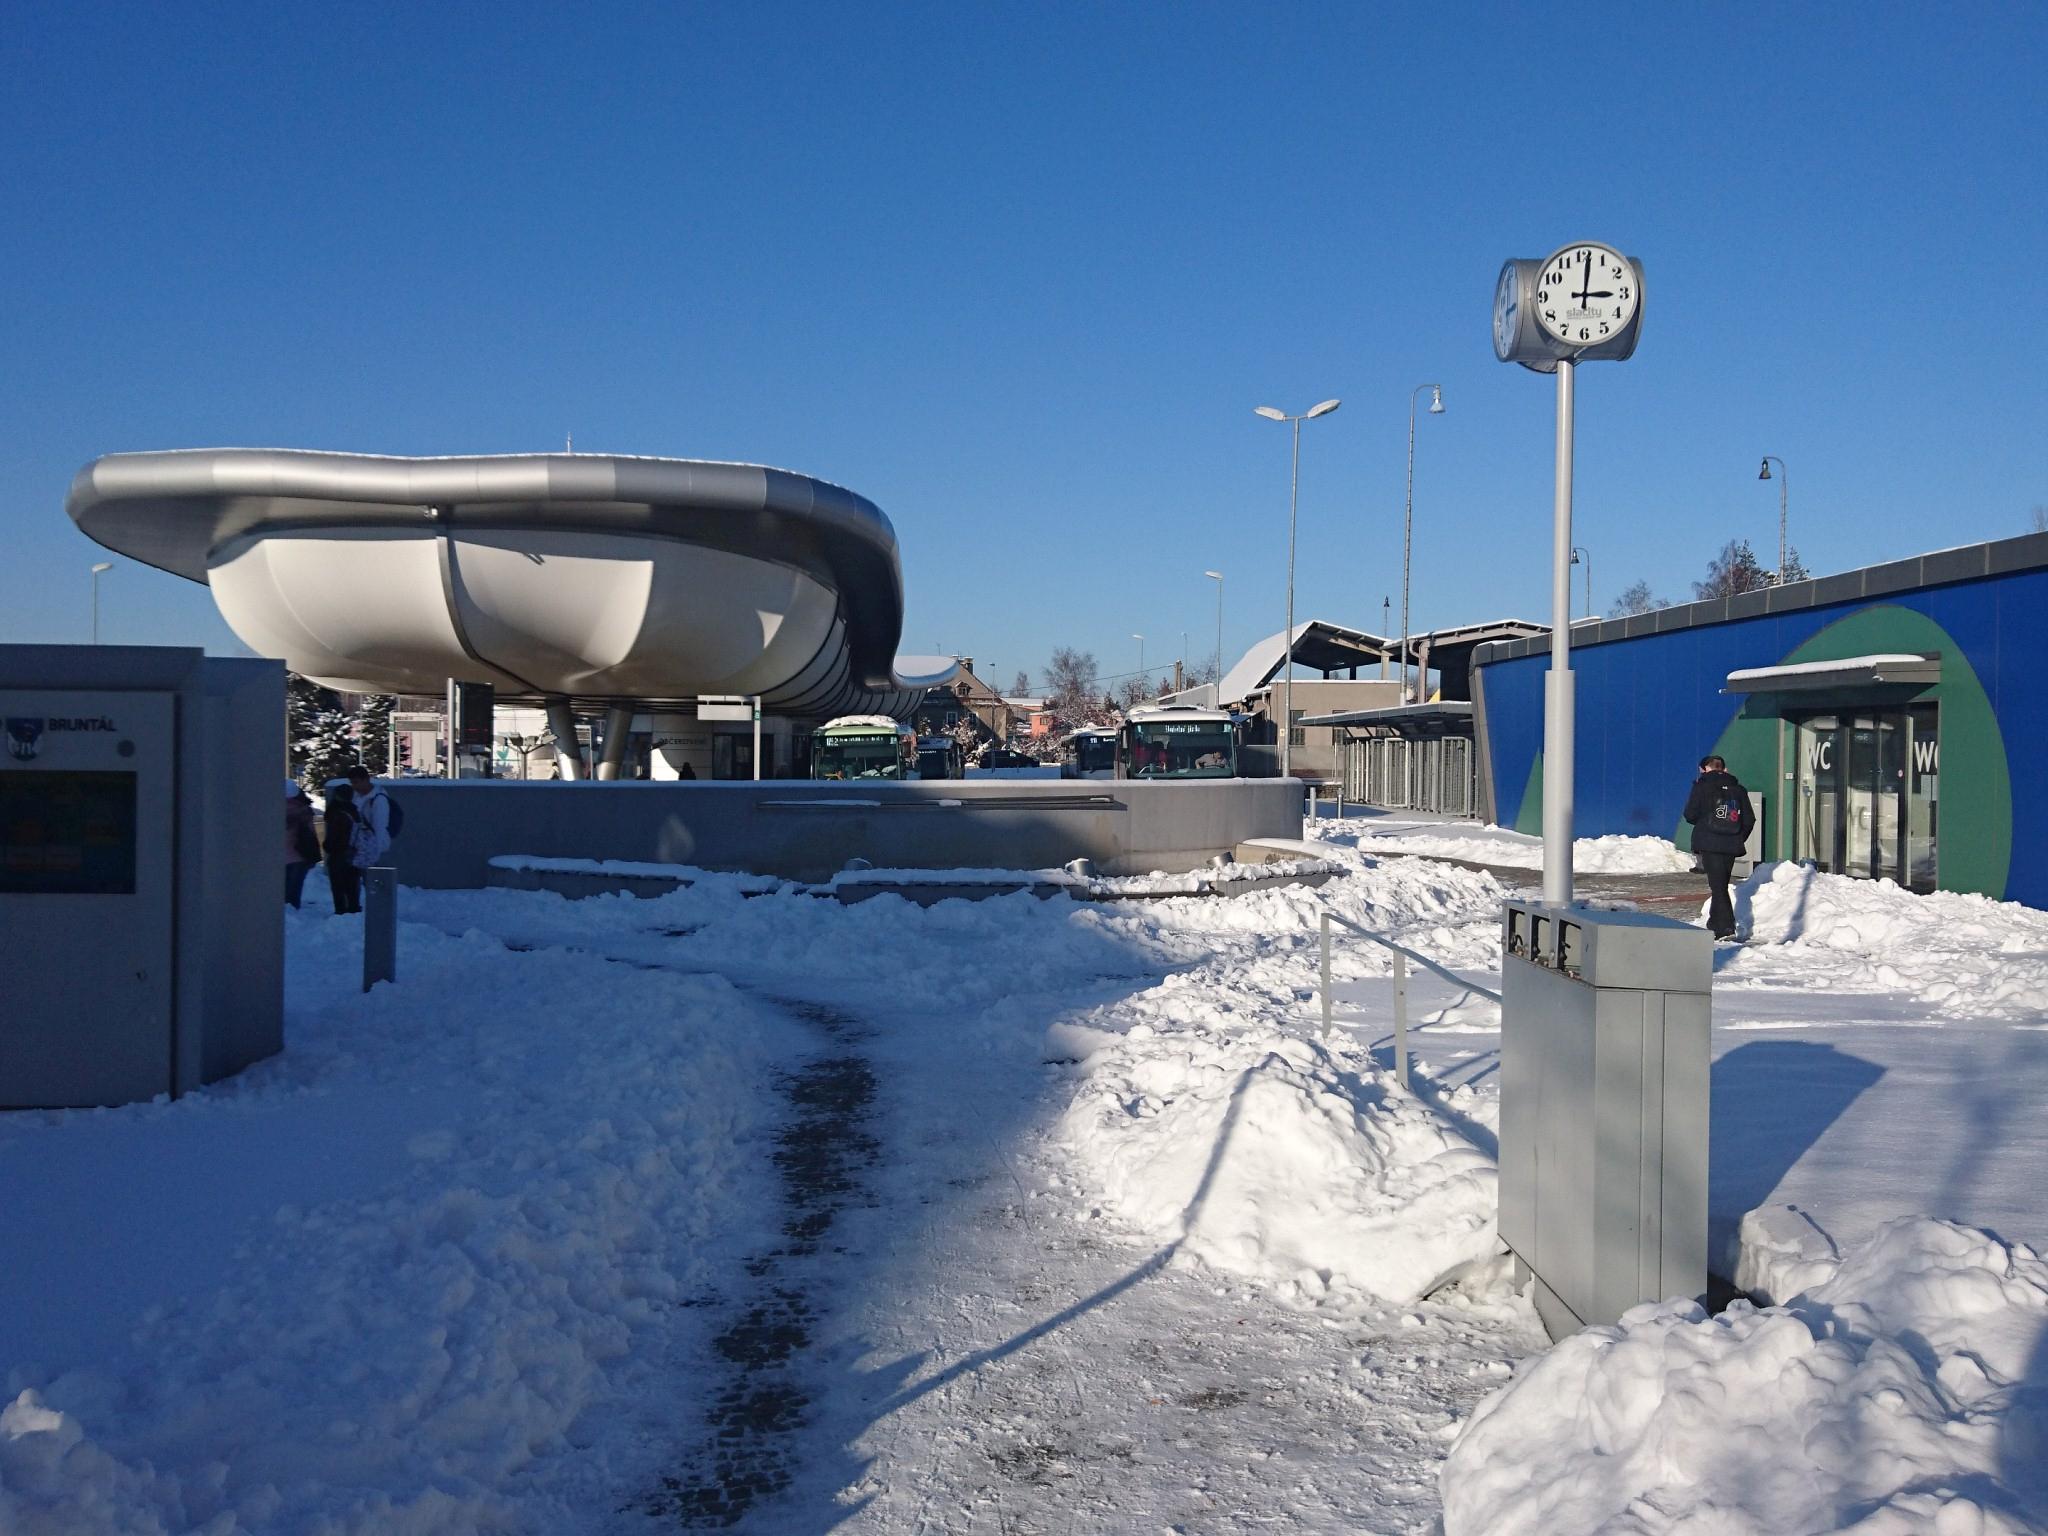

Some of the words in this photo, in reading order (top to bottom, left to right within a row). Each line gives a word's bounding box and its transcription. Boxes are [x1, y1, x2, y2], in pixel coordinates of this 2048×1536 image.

[1558, 256, 1571, 269] 11
[1600, 254, 1605, 267] 1
[1545, 272, 1563, 285] 10
[1612, 266, 1623, 280] 2
[1538, 290, 1549, 304] 9
[1619, 286, 1630, 300] 3
[1545, 309, 1556, 322] 8
[1611, 306, 1622, 319] 4
[1559, 323, 1570, 337] 7
[1579, 327, 1590, 341] 6
[1599, 321, 1610, 335] 5
[48, 715, 118, 732] BRUNTÁL
[1914, 741, 1938, 772] W
